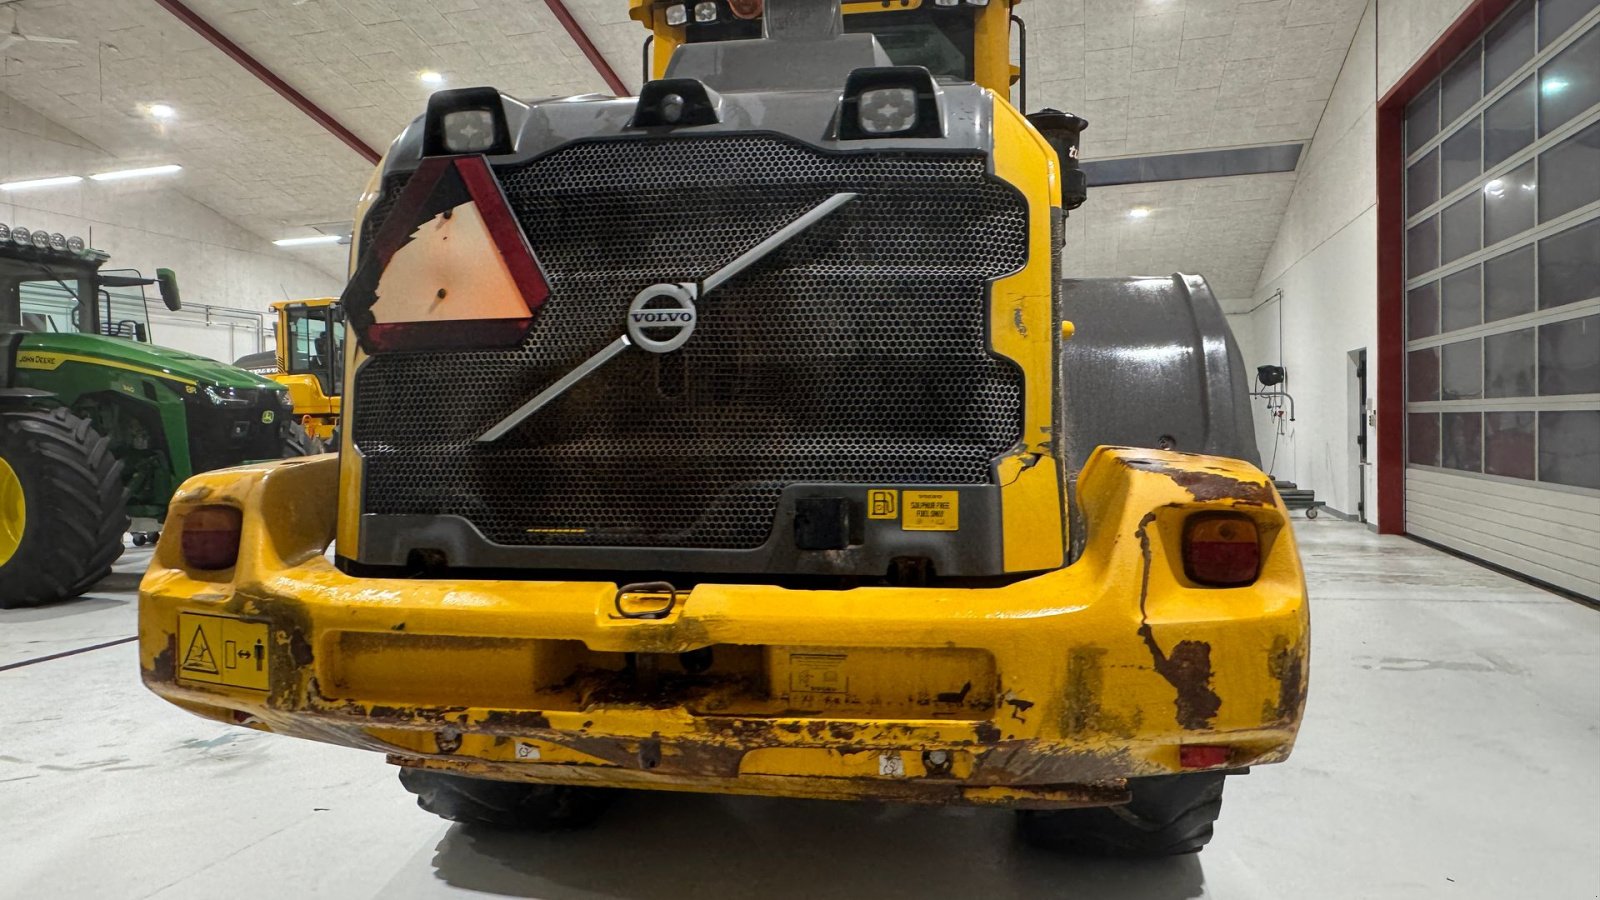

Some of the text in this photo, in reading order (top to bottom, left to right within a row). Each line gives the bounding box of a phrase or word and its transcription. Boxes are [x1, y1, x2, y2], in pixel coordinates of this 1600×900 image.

[631, 312, 692, 322] VOLVO
[936, 502, 950, 510] FREE
[916, 510, 929, 518] FUEL
